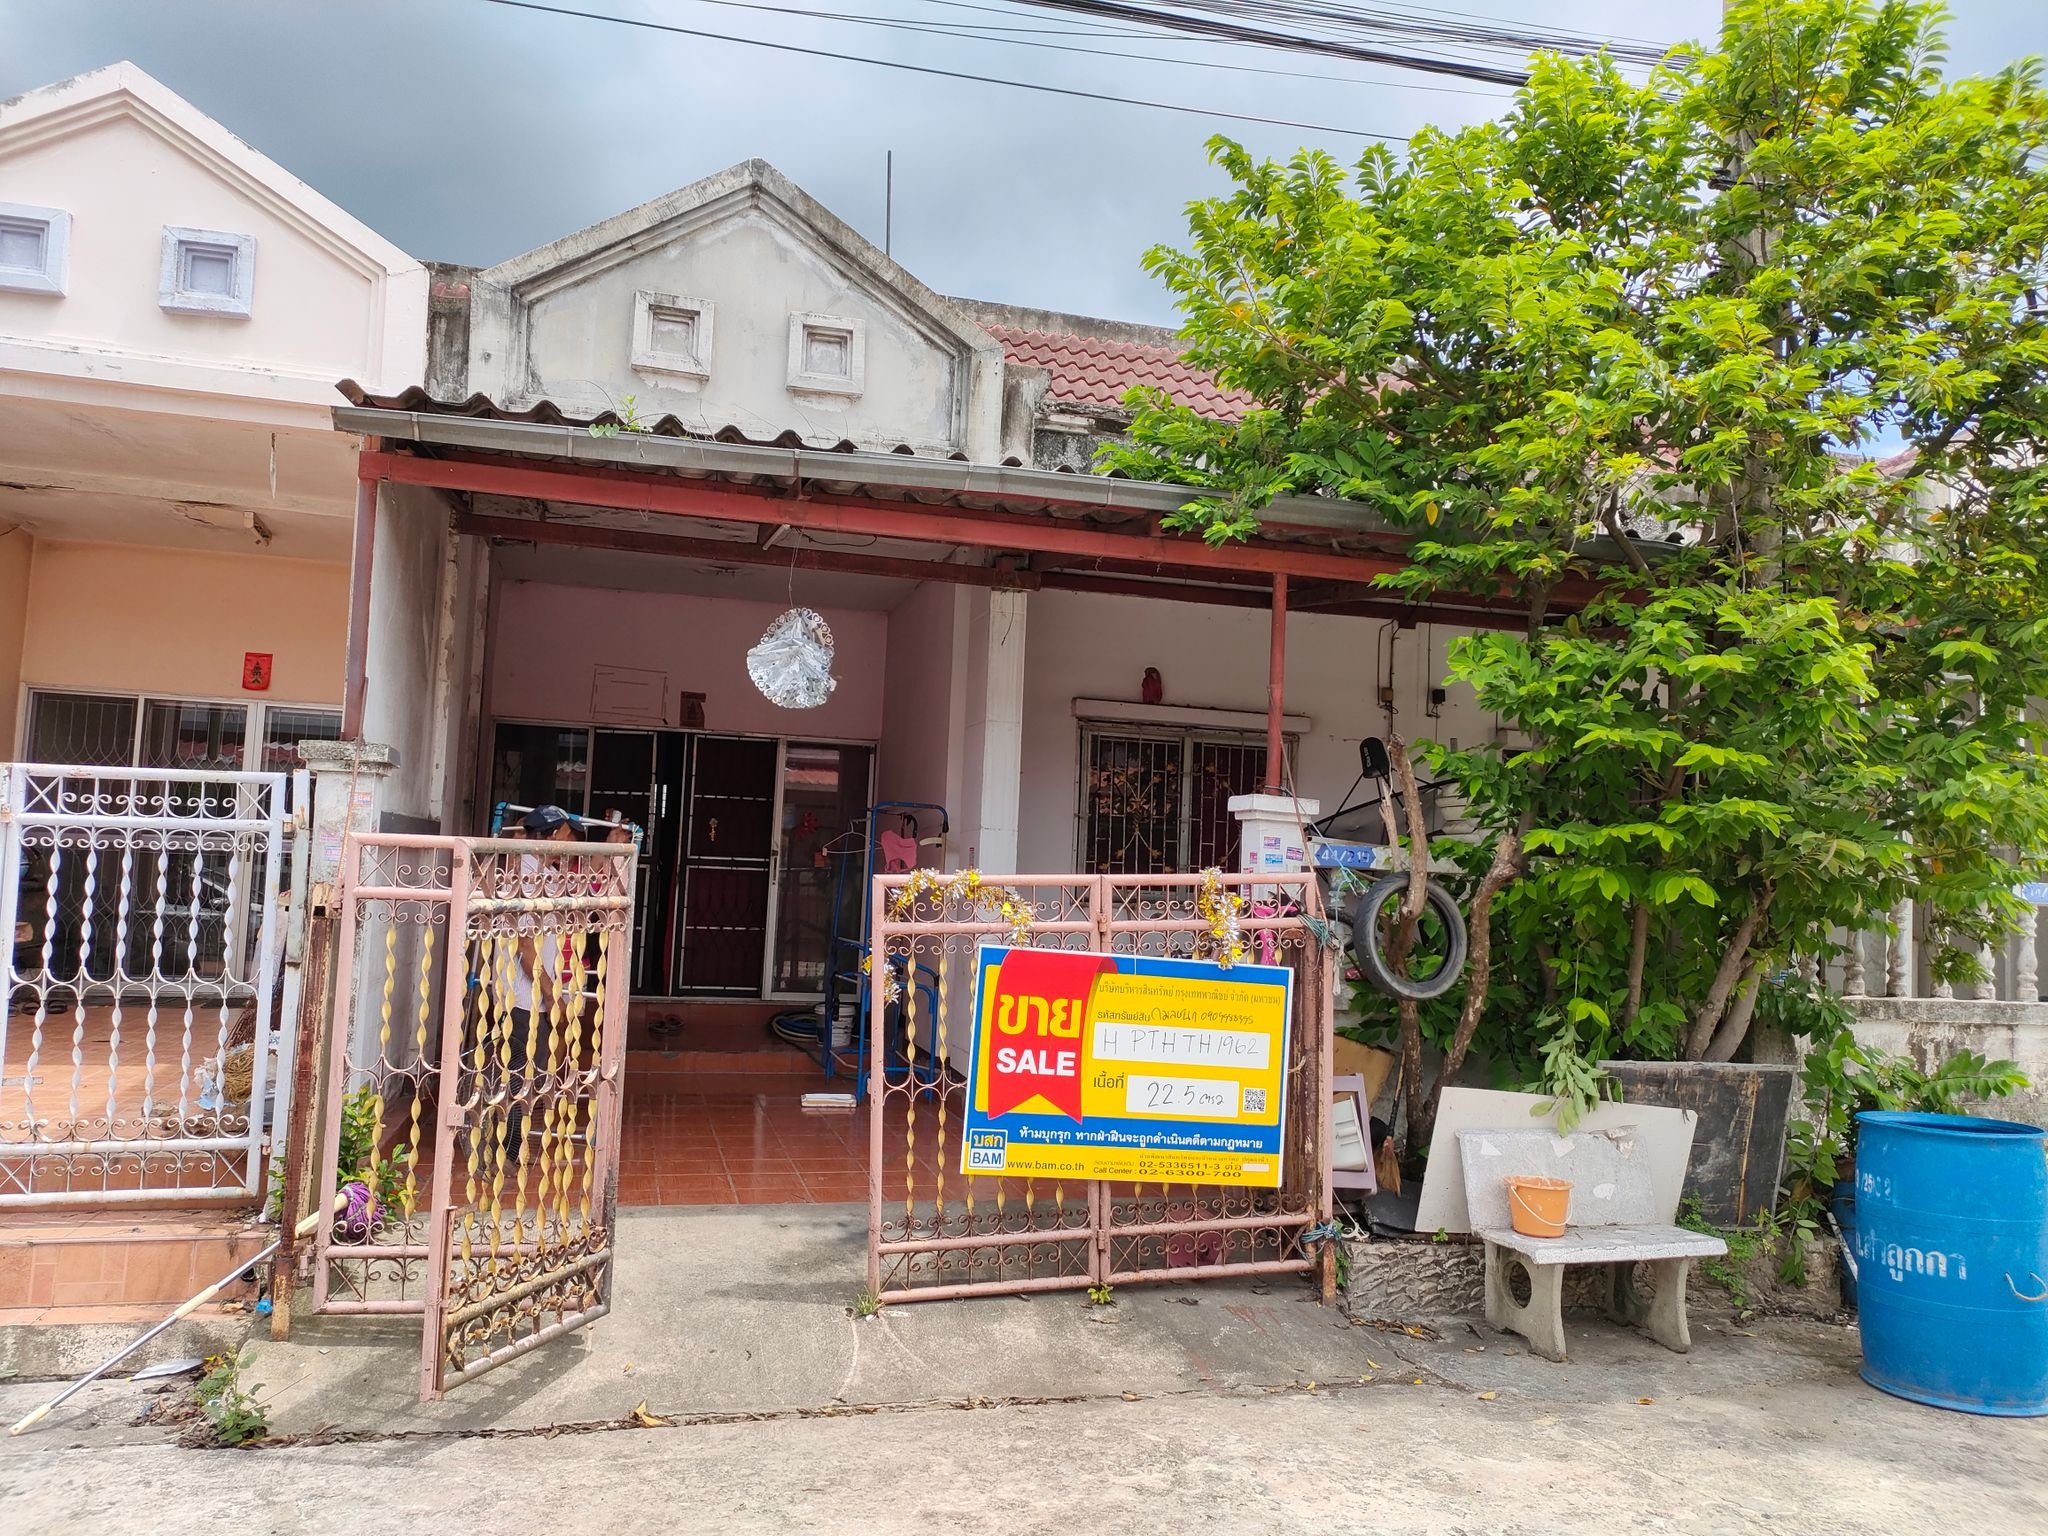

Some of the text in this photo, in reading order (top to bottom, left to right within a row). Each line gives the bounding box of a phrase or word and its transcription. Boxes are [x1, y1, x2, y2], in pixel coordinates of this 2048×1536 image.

[1230, 990, 1249, 1003] จำกัด
[1251, 994, 1281, 1006] (มหาชน)
[998, 994, 1083, 1039] ขาย
[996, 1047, 1076, 1077] SALE
[1093, 1071, 1125, 1089] เนื้อที่
[973, 1133, 1003, 1148] บสก
[1019, 1127, 1263, 1151] ห้ามบุกรุก หากฝ่าฝืนจะถูกดำเนินคดีตามกฎหมาย
[972, 1151, 1002, 1165] BAM
[1007, 1160, 1085, 1172] www.bam.co.th
[1093, 1166, 1242, 1178] Call Center 02-6300-700
[1139, 1161, 1220, 1171] 02-5336511-3
[1225, 1162, 1242, 1171] ต่อ
